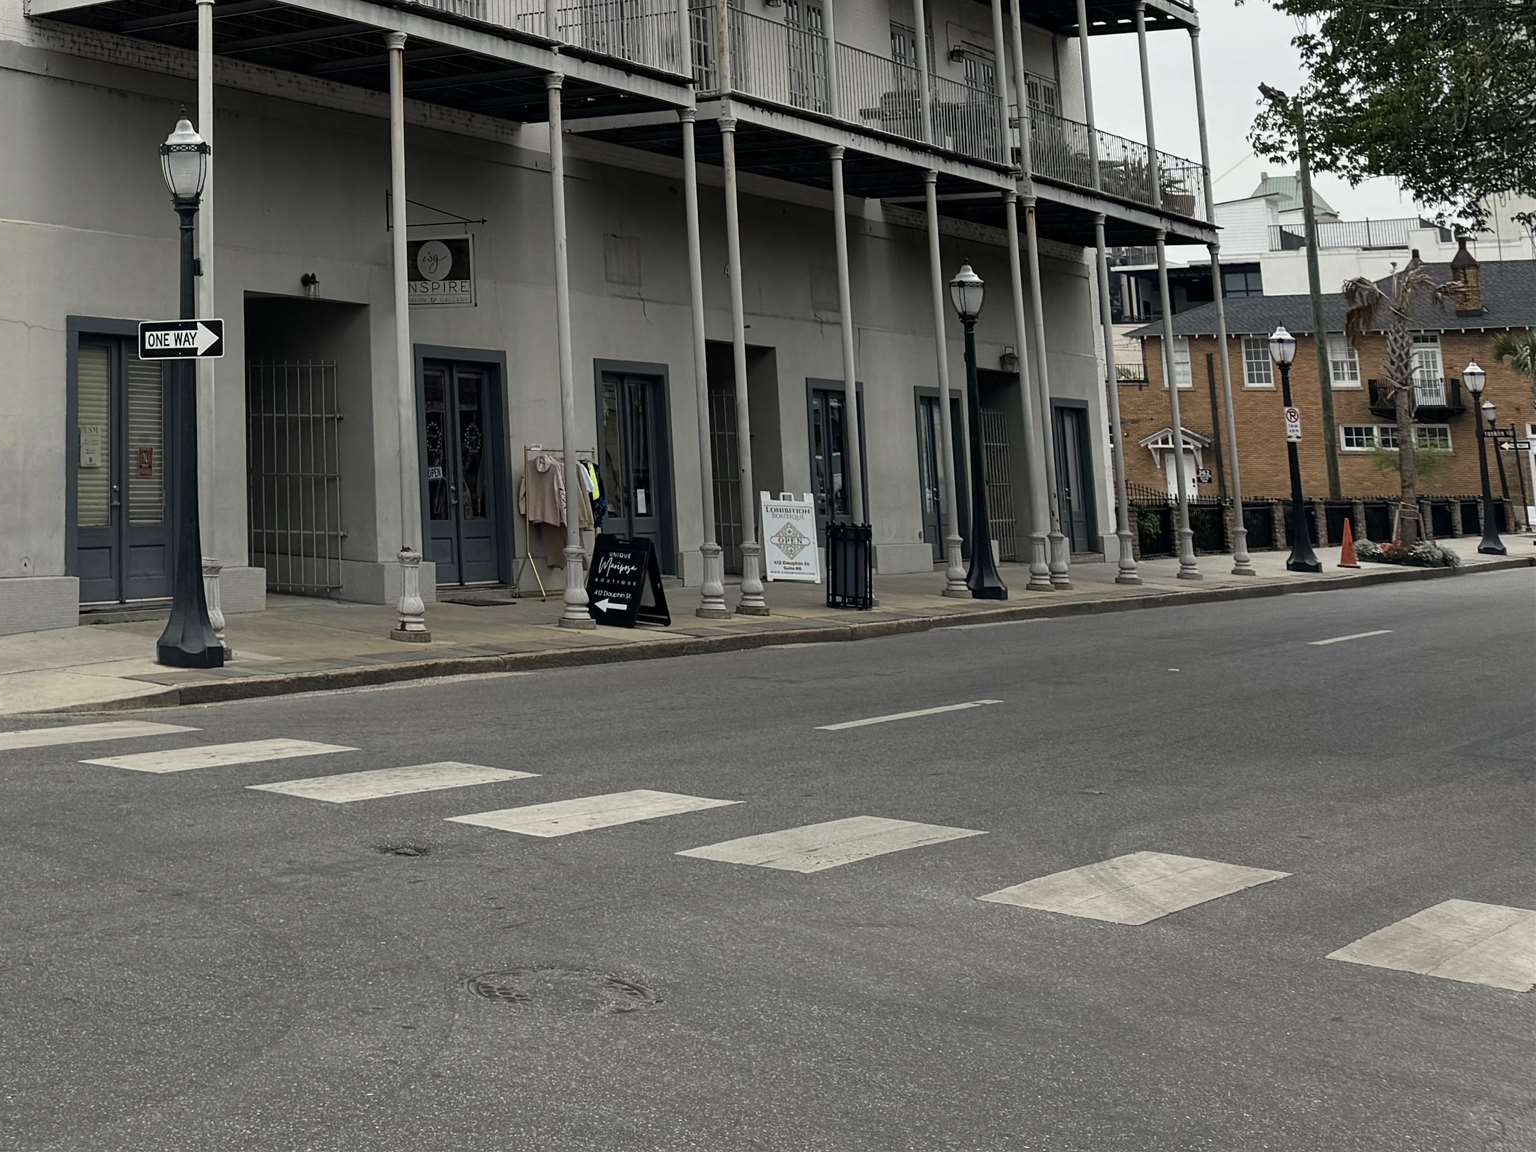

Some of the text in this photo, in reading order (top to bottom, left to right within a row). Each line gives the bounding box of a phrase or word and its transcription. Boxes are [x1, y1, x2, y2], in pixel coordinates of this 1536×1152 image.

[407, 280, 470, 294] NSPIRE
[147, 331, 198, 348] ONE WAY
